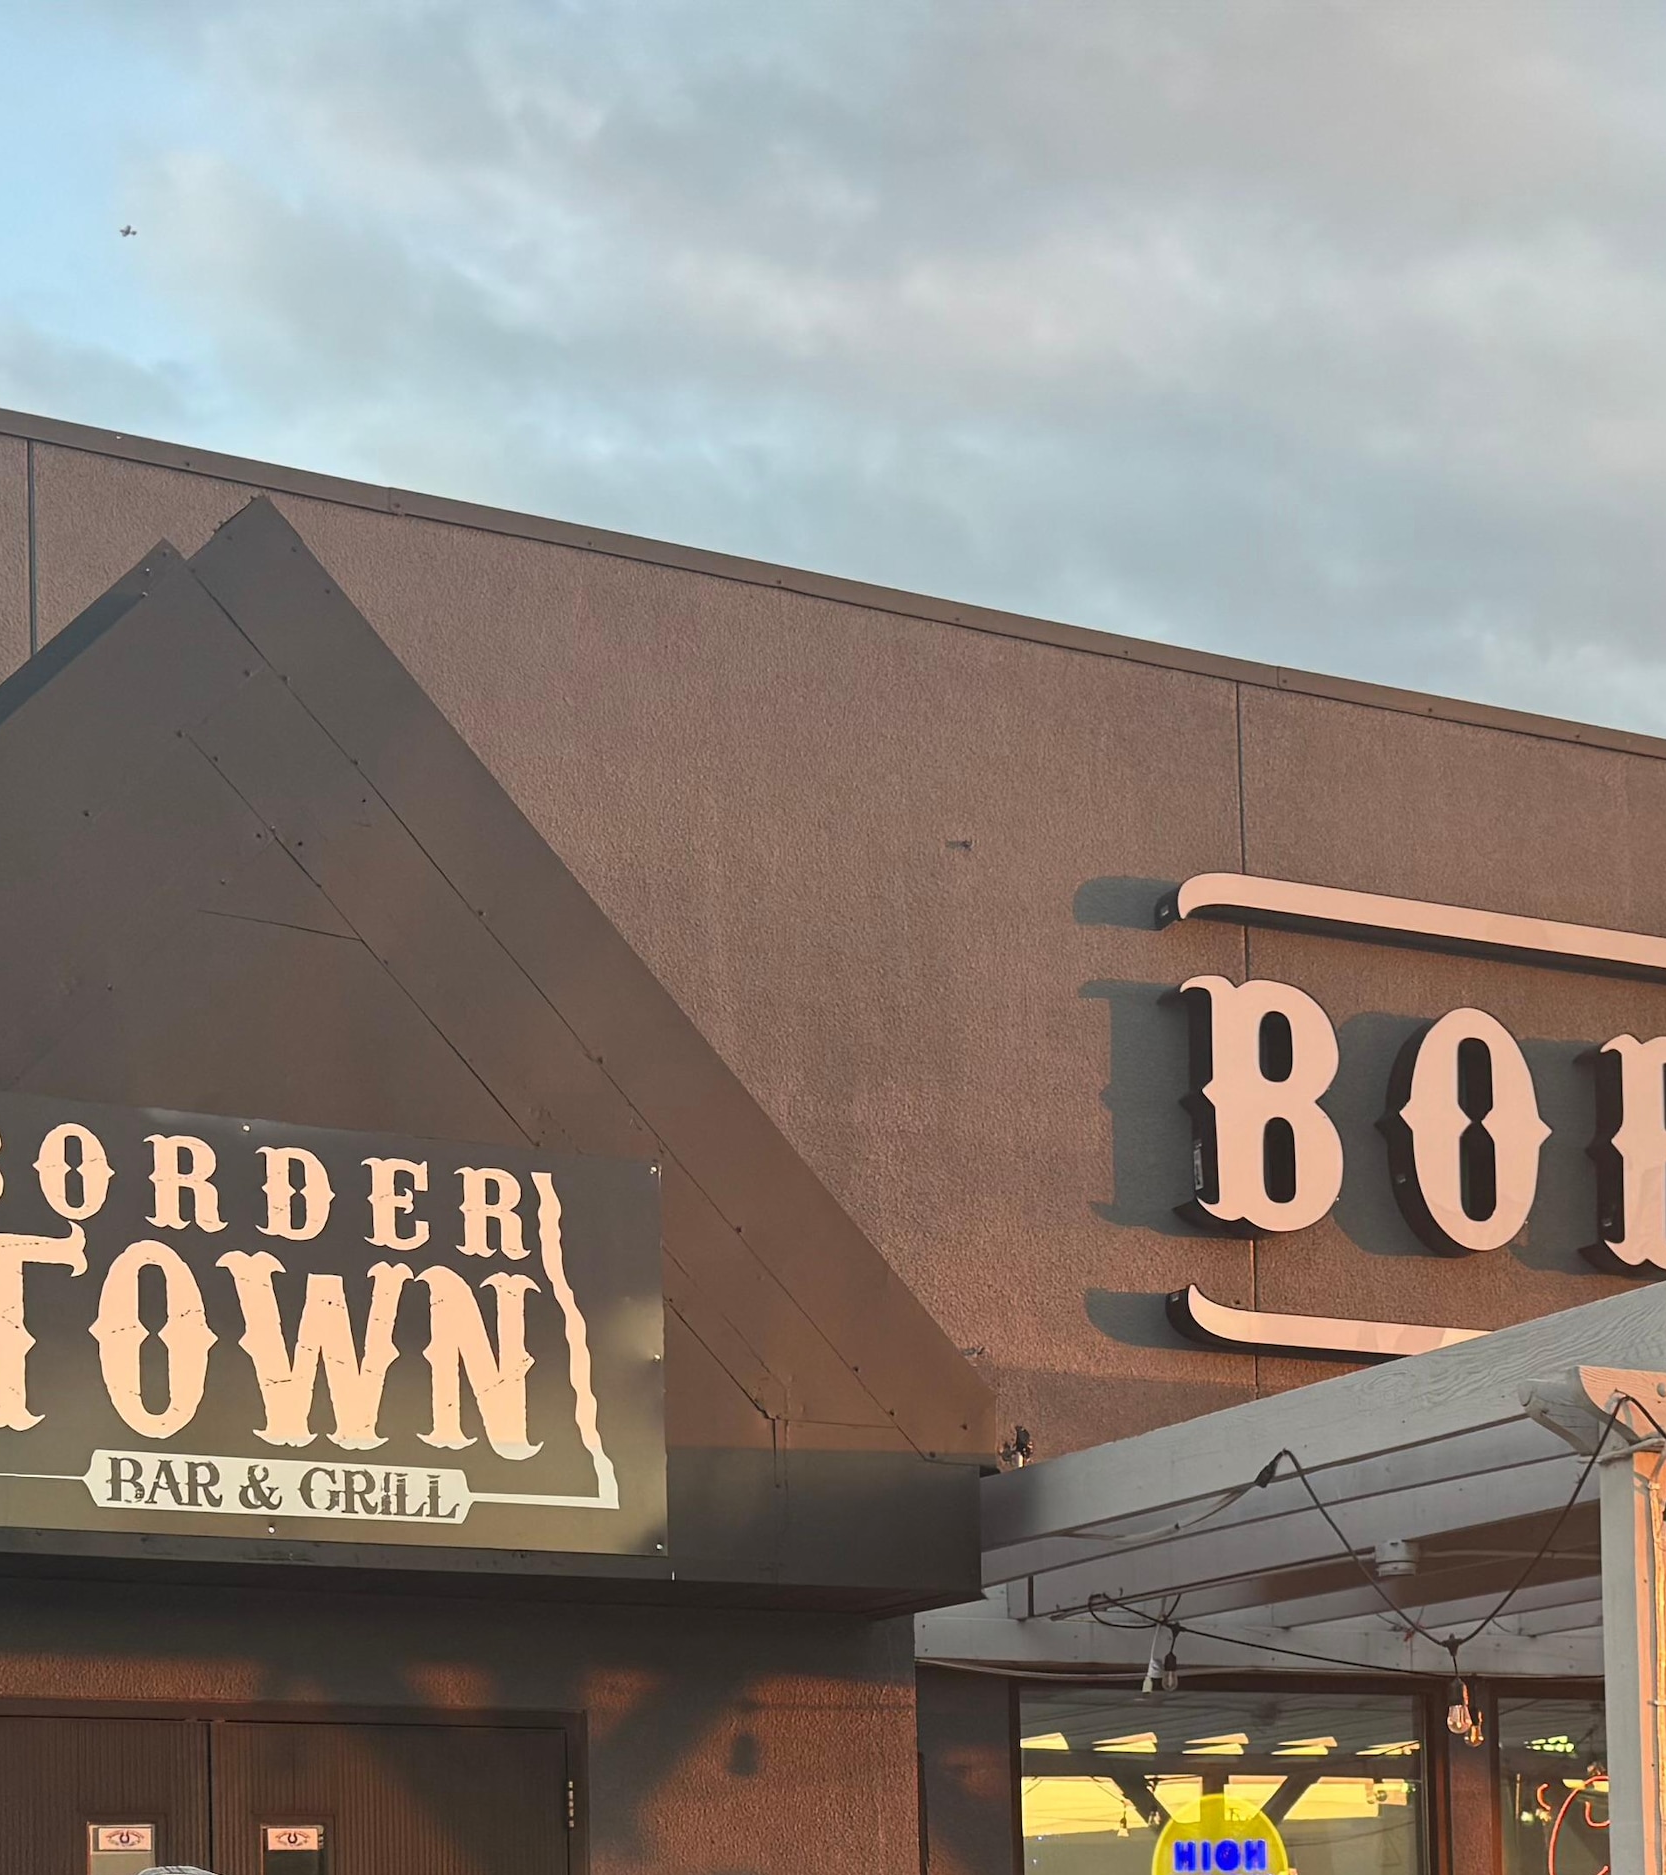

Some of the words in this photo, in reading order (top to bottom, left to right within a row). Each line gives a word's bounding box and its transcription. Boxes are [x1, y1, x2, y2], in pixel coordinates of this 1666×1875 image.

[106, 1456, 224, 1509] BAR
[238, 1463, 283, 1511] &
[297, 1466, 461, 1519] GRILL
[1174, 1839, 1267, 1872] HIGH
